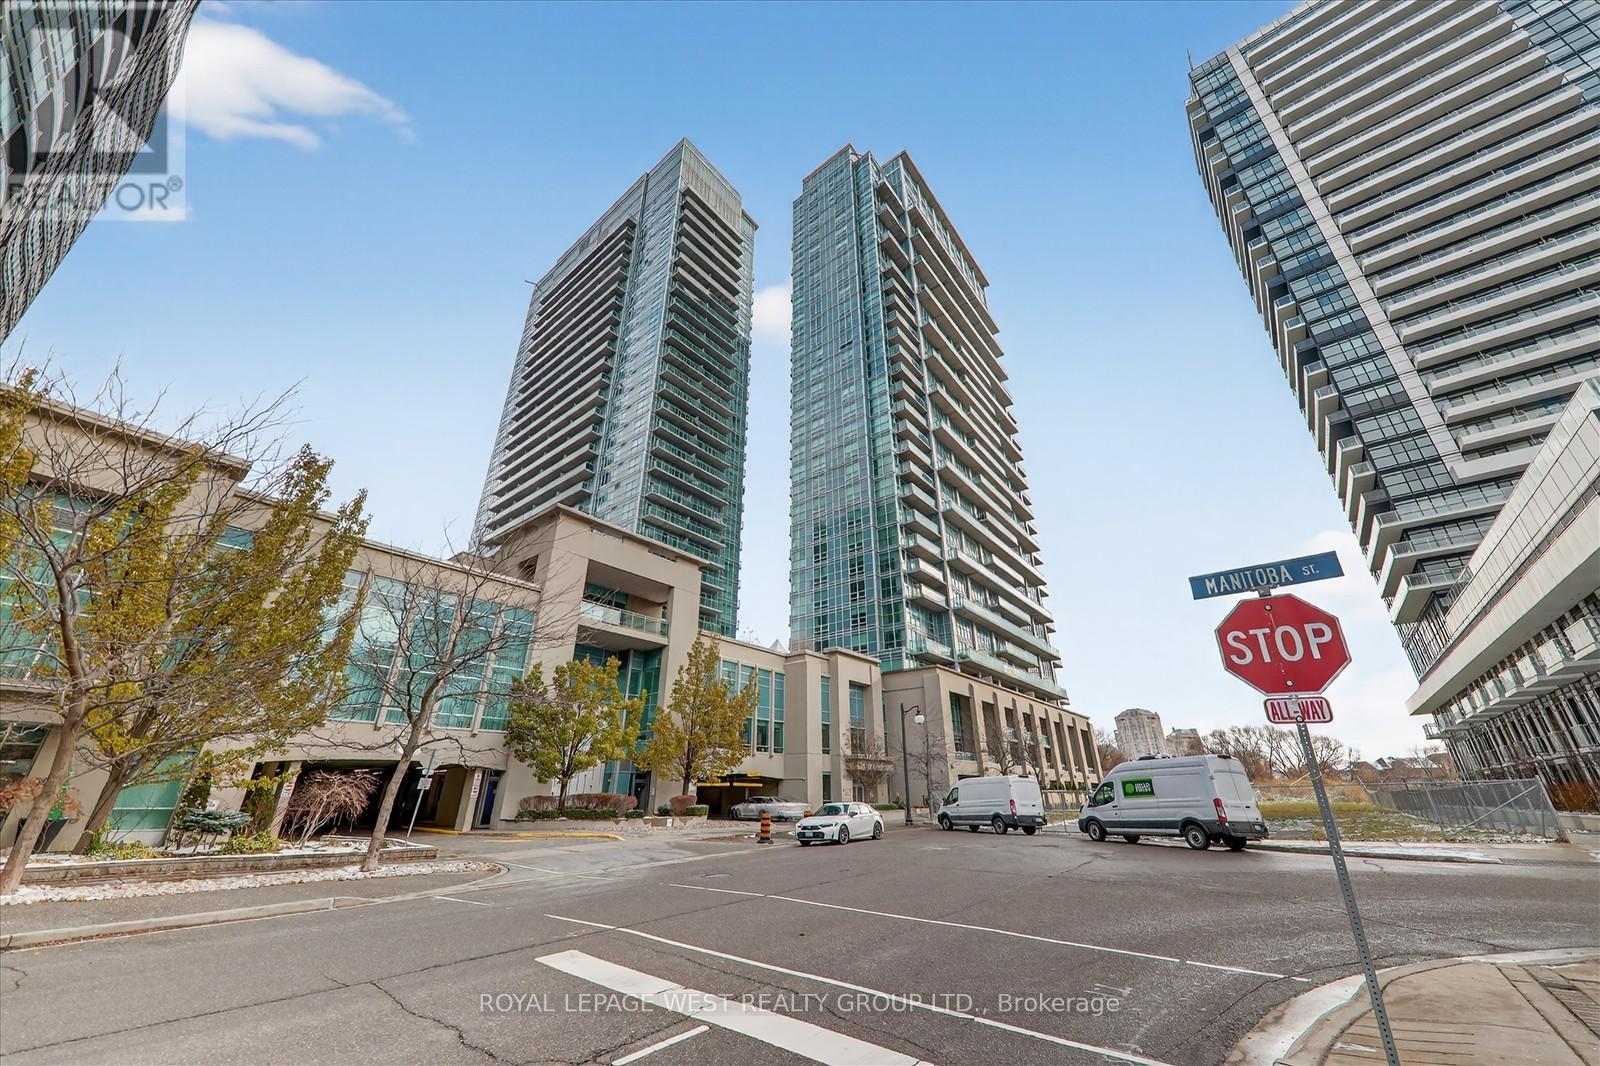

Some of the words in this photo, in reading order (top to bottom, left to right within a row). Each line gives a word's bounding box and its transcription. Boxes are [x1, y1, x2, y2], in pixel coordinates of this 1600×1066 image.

[1204, 565, 1294, 595] MANITOBA
[1226, 622, 1333, 666] STOP
[1270, 699, 1327, 721] ALL-WAY
